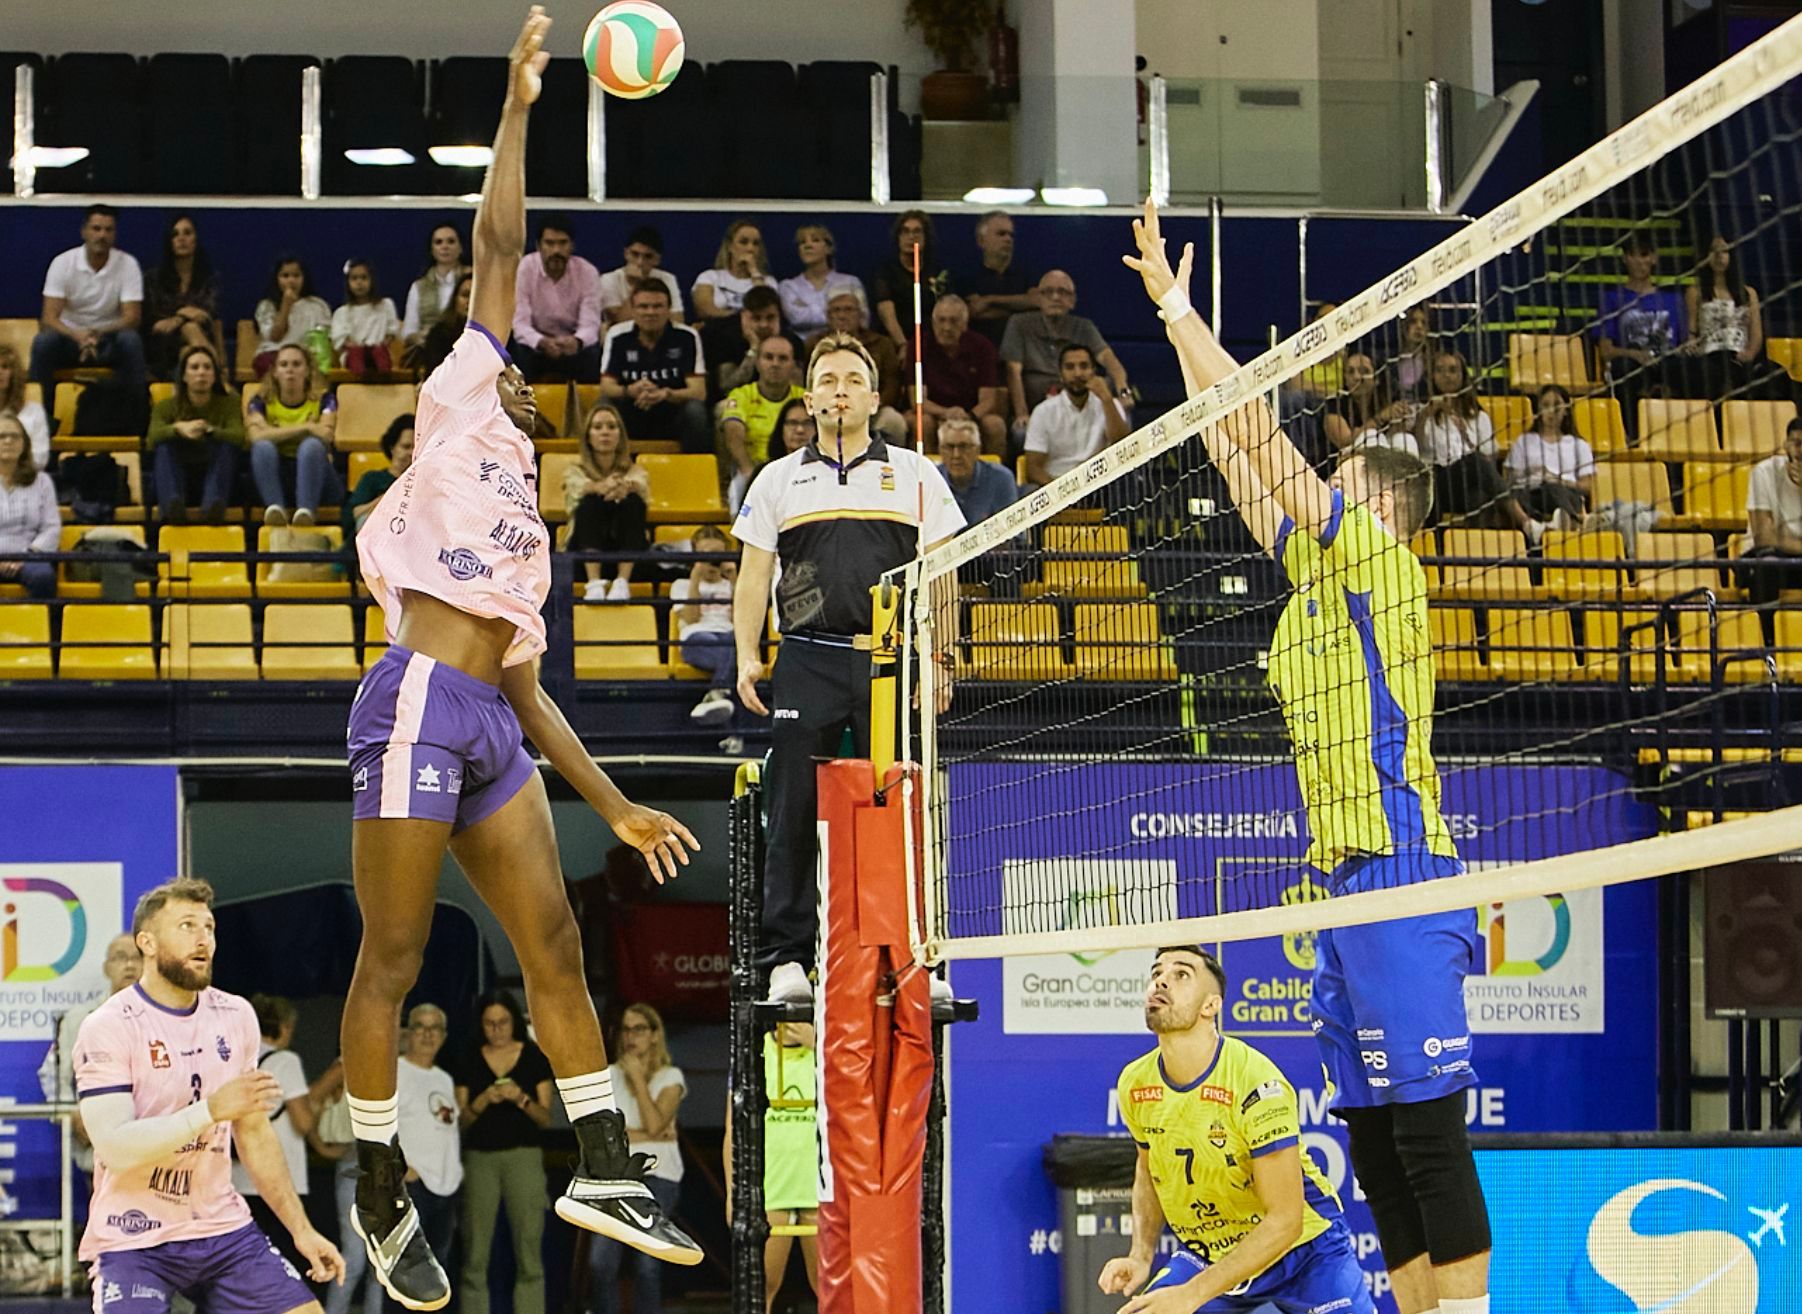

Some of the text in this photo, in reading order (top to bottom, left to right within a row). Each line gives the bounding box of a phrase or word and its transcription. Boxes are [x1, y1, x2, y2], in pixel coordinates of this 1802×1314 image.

[1131, 809, 1298, 839] CONSEJERÍA
[1021, 997, 1147, 1010] Isla Europea del Depo
[1232, 1001, 1288, 1023] Gran
[1481, 1004, 1580, 1021] DEPORTES
[1175, 1148, 1195, 1185] 7
